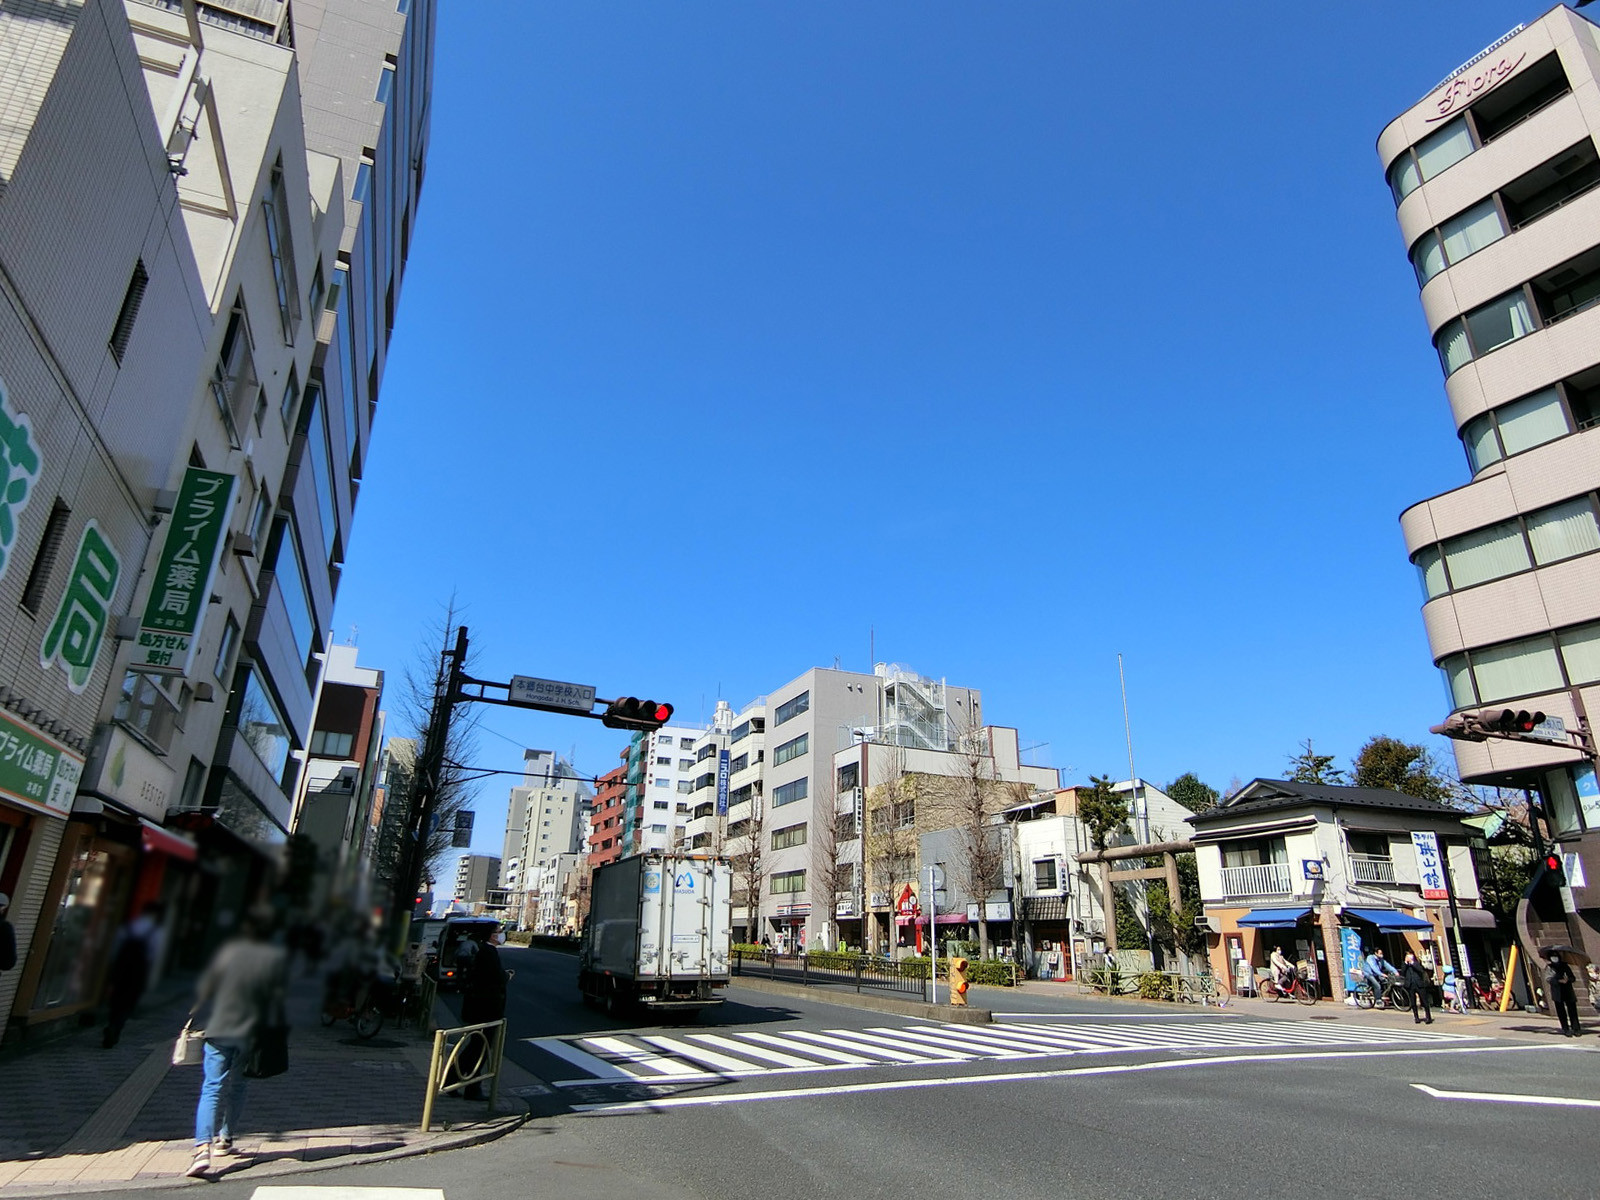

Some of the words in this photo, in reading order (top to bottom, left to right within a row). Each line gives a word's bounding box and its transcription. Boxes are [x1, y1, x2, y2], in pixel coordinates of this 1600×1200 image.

[158, 477, 224, 615] プライム薬局
[138, 632, 188, 651] 処方せん
[146, 650, 173, 666] 受付
[516, 680, 592, 700] 本郷台中学校入口
[0, 731, 54, 780] プライム薬局
[1413, 832, 1434, 841] ホテル
